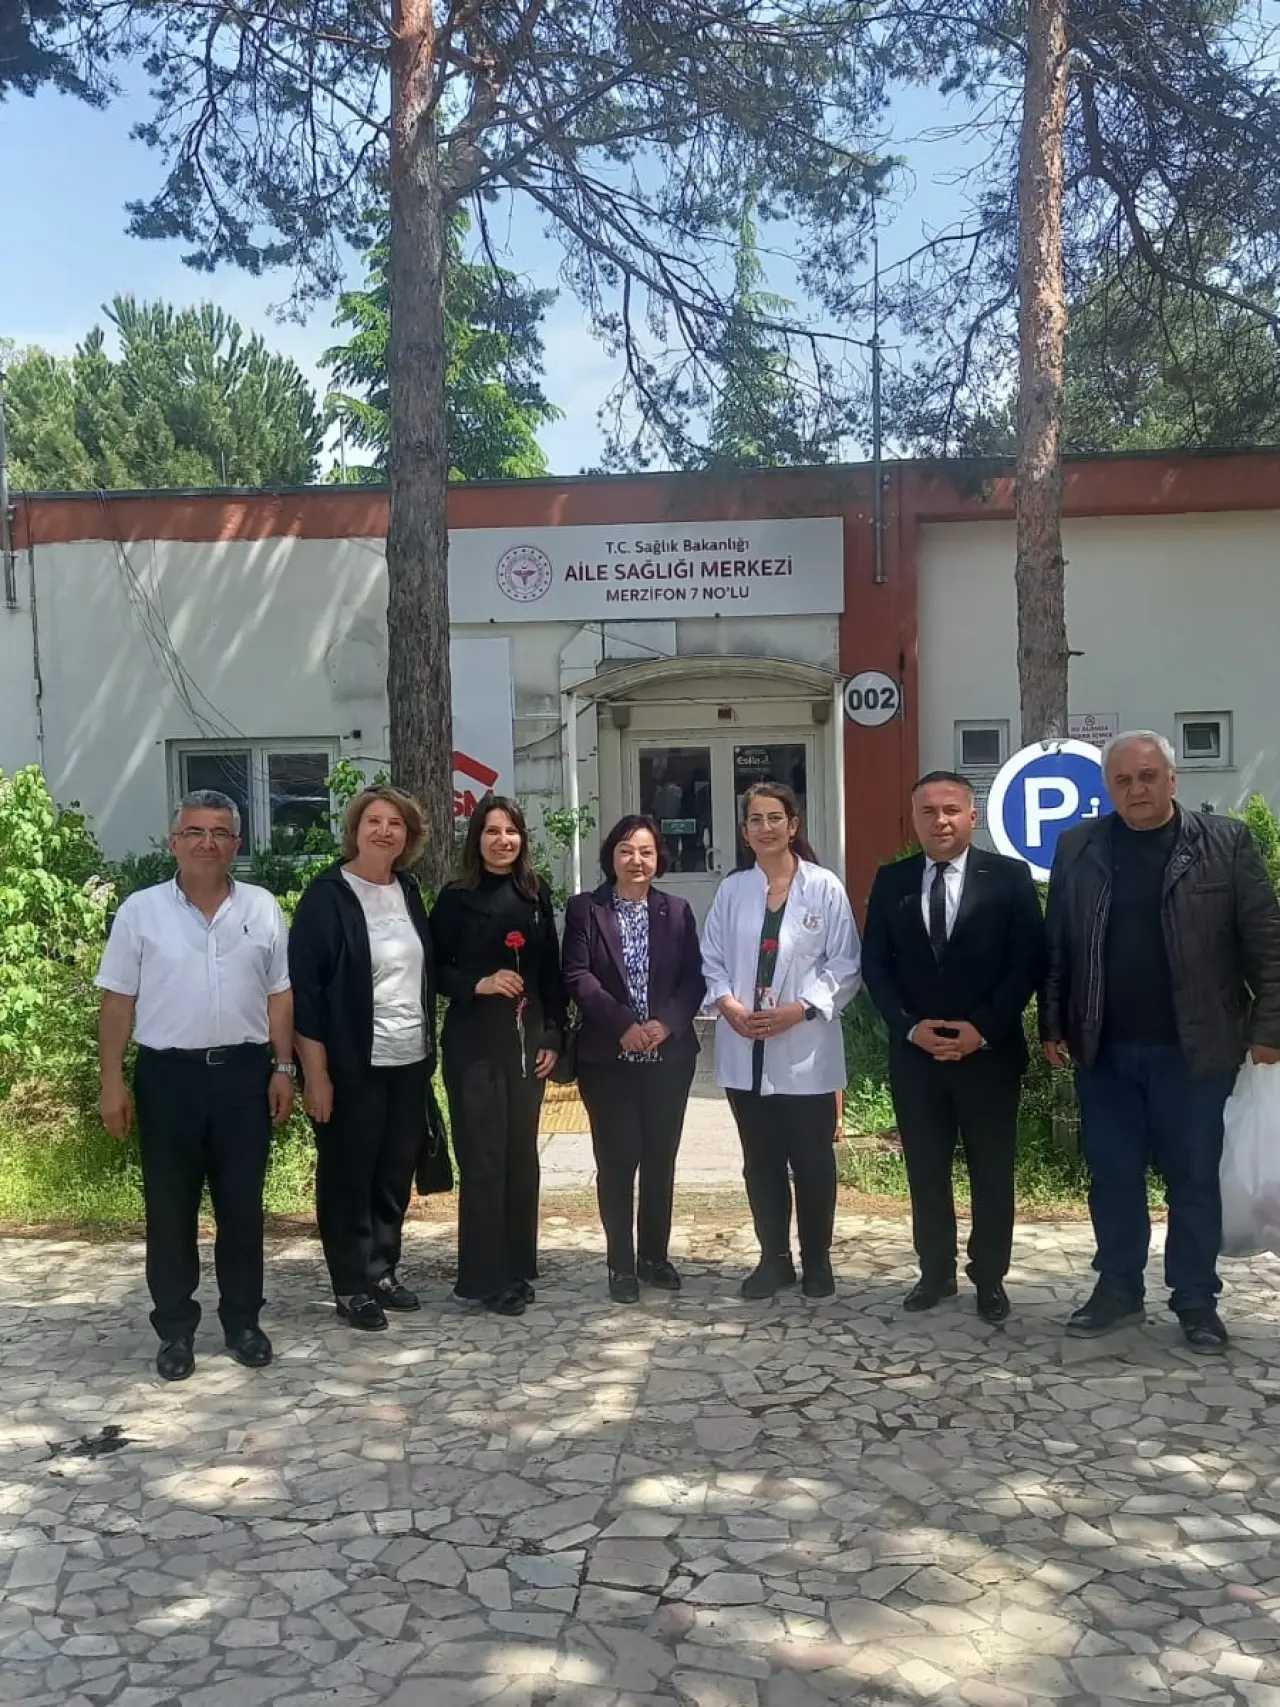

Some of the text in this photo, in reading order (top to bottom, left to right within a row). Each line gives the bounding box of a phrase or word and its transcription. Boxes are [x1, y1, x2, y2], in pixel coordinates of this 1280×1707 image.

[605, 537, 749, 555] T.C. Sağlık Bakanlığı
[564, 560, 609, 582] AİLE
[614, 558, 694, 580] SAĞLIĞI
[701, 555, 792, 578] MERKEZİ
[606, 586, 749, 602] MERZİFON 7 NO'LU
[848, 686, 896, 711] 002
[1023, 776, 1079, 848] P
